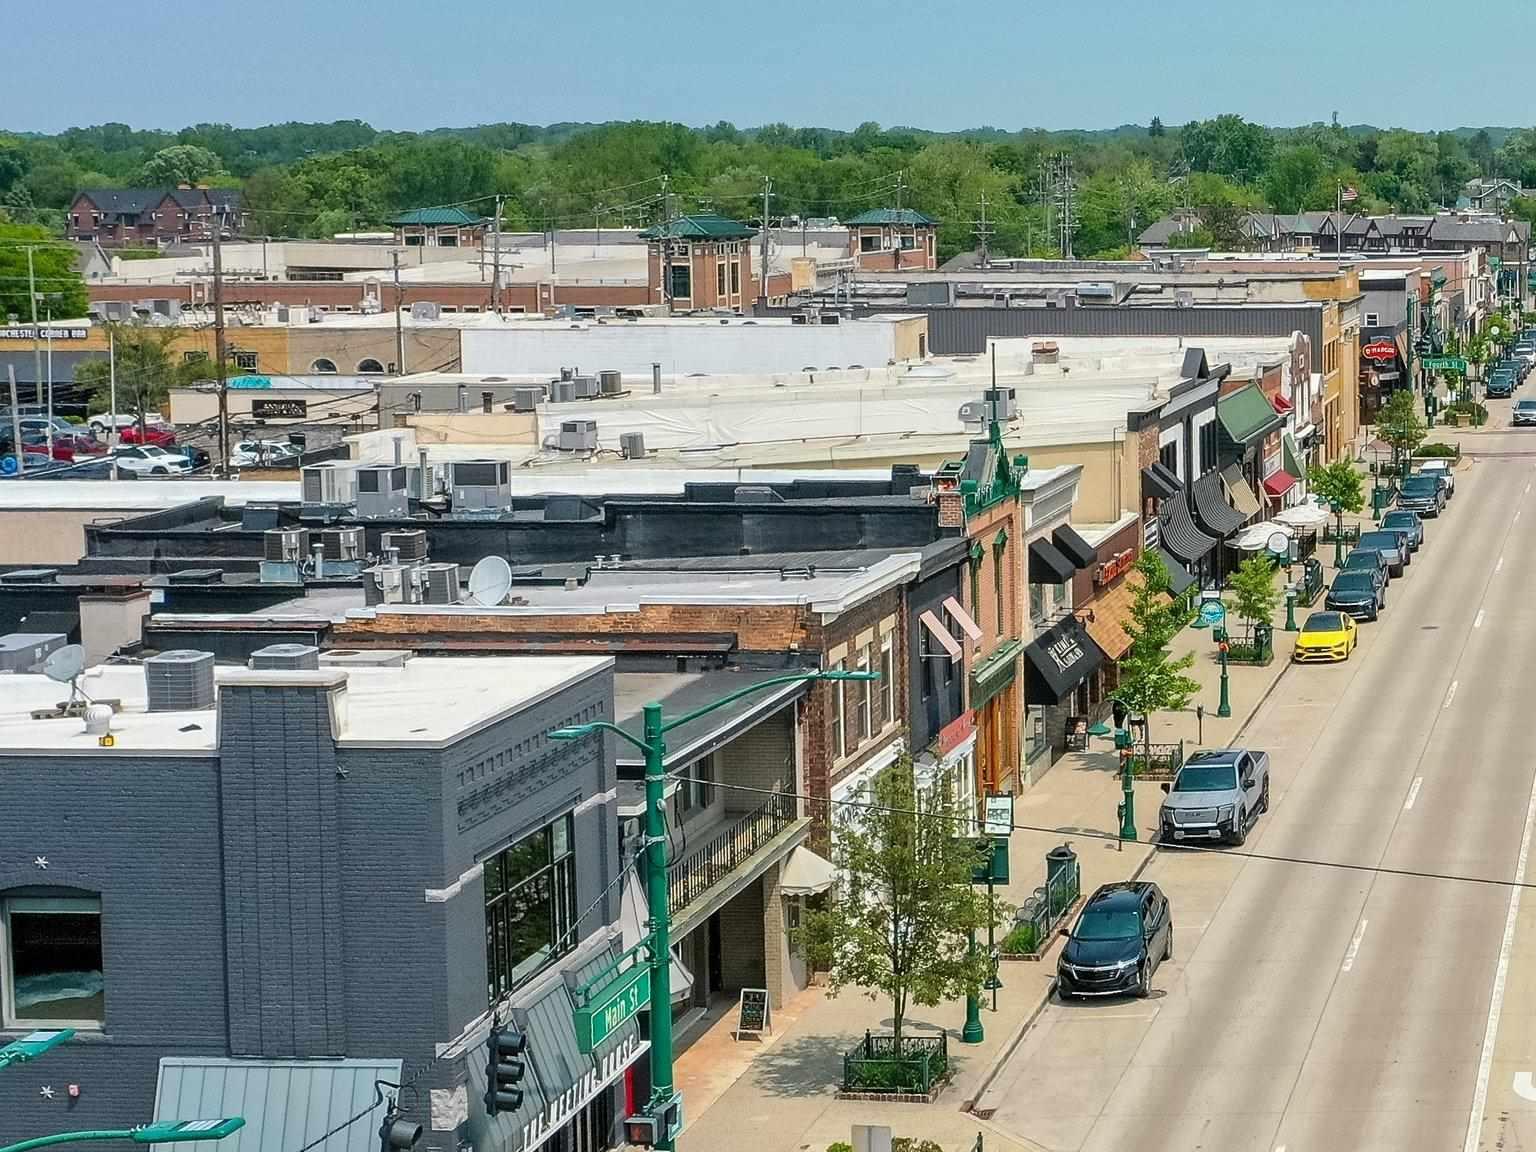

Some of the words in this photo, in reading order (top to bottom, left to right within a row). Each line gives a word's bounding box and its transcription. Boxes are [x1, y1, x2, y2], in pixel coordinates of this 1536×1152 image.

[605, 997, 626, 1033] Main
[630, 984, 638, 1011] St
[524, 1111, 545, 1152] THE
[550, 1068, 599, 1128] MEETING
[602, 1033, 637, 1082] HOUSE
